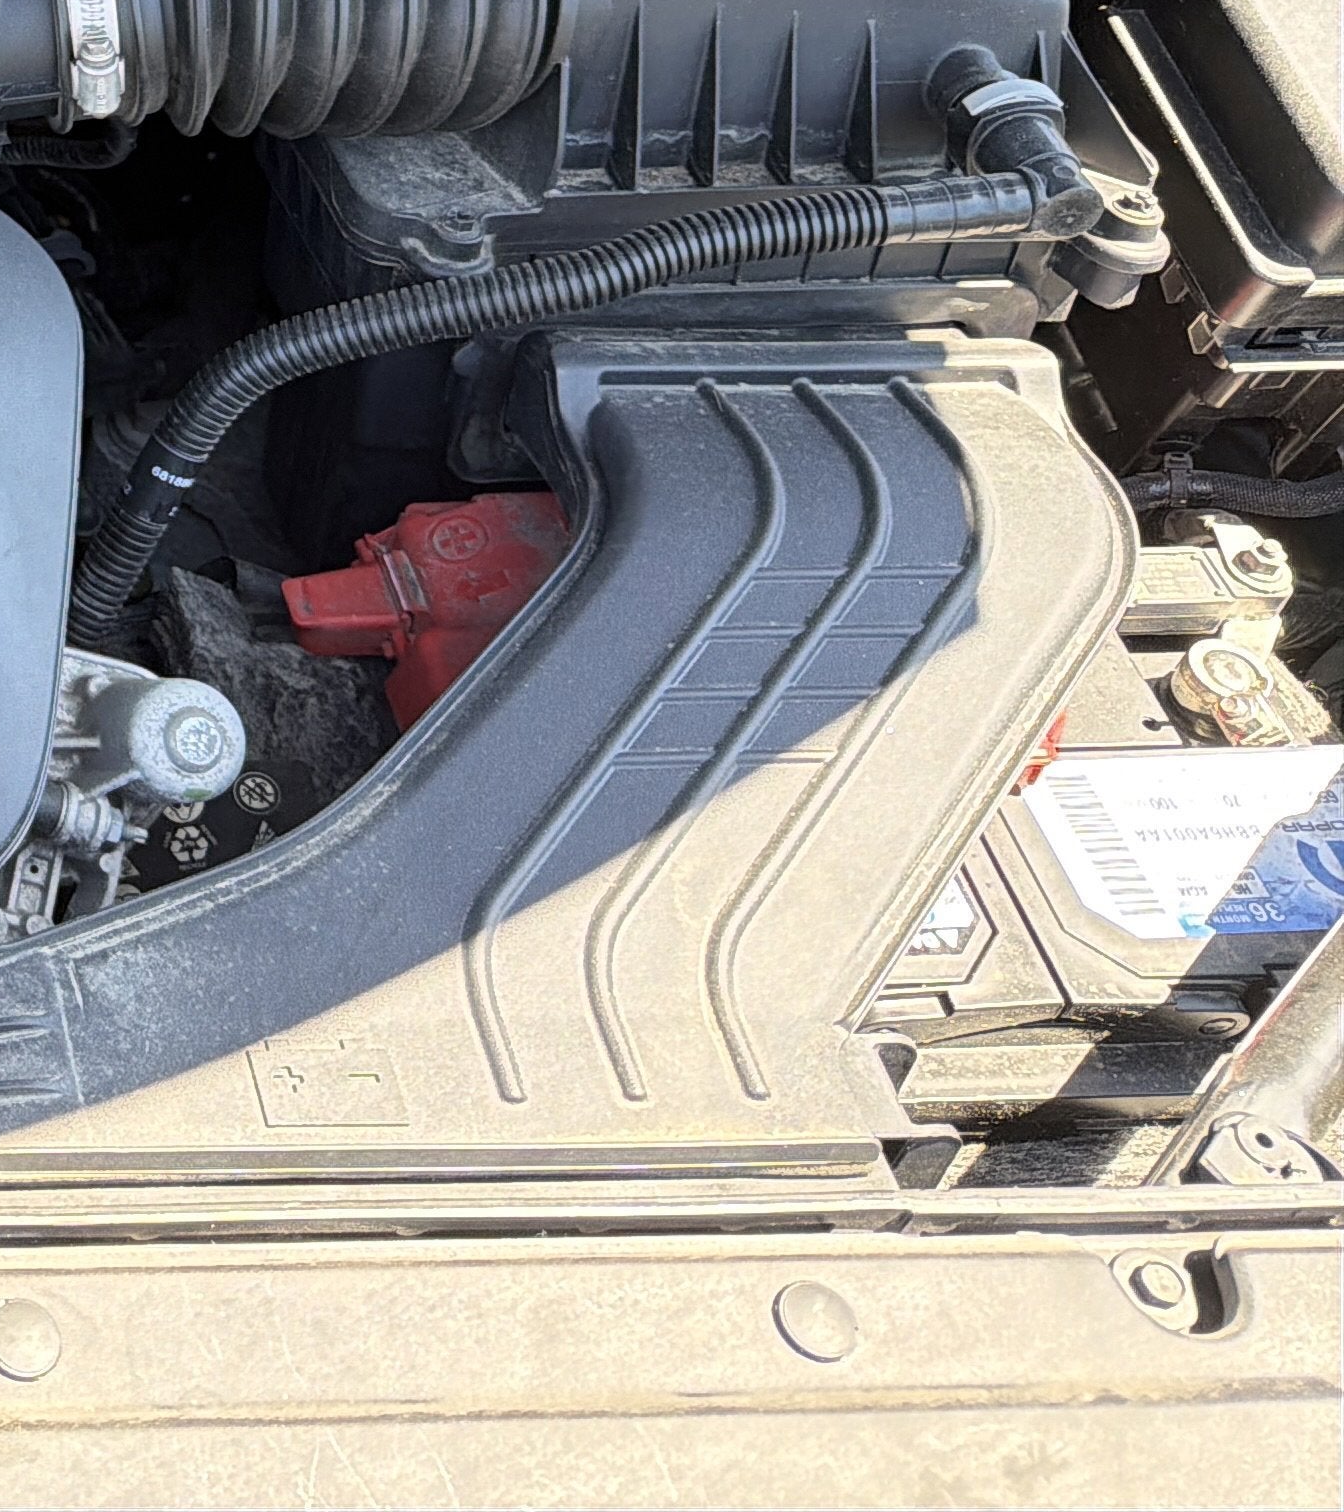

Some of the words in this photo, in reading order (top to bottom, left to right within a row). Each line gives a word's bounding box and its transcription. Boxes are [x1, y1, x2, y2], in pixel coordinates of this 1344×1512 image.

[1281, 819, 1344, 833] OPAR
[1212, 913, 1252, 924] MONTH
[1247, 900, 1286, 923] 36
